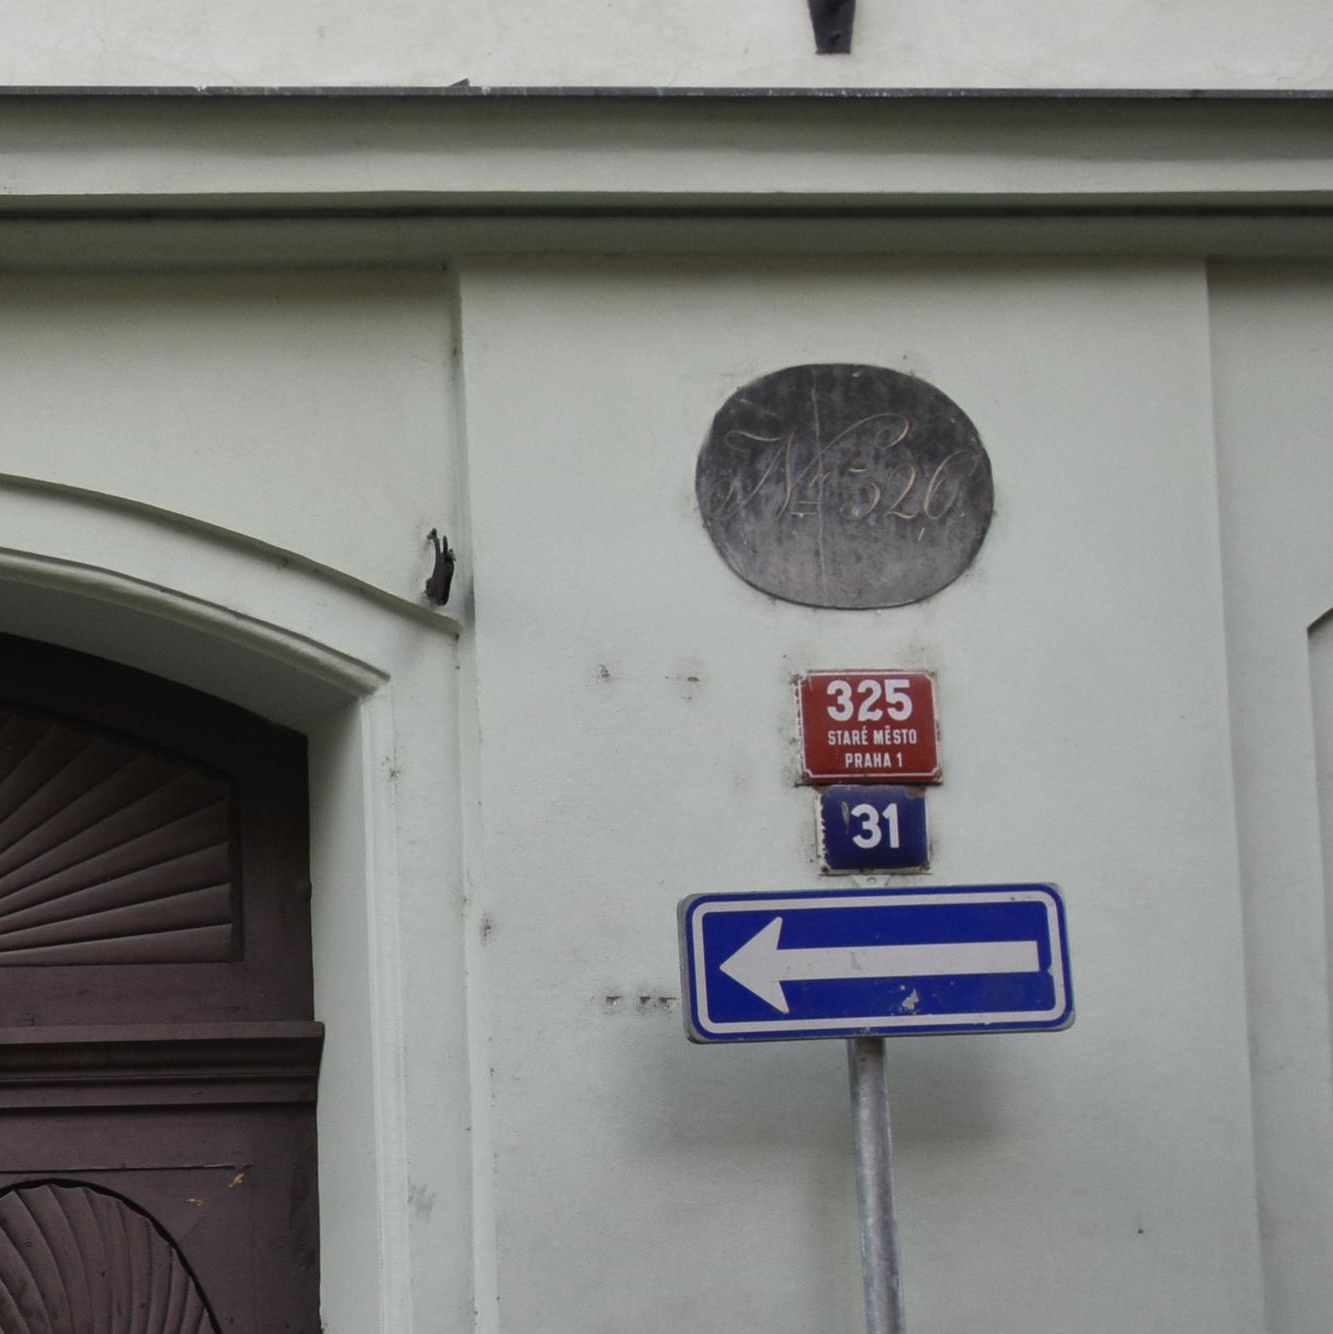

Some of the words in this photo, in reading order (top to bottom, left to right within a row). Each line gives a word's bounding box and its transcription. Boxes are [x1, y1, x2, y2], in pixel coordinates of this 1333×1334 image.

[826, 679, 913, 722] 325
[828, 726, 869, 745] STARÉ
[873, 726, 917, 745] MĚSTO
[845, 752, 892, 768] PRAHA
[896, 752, 903, 767] 1
[851, 803, 899, 849] 31
